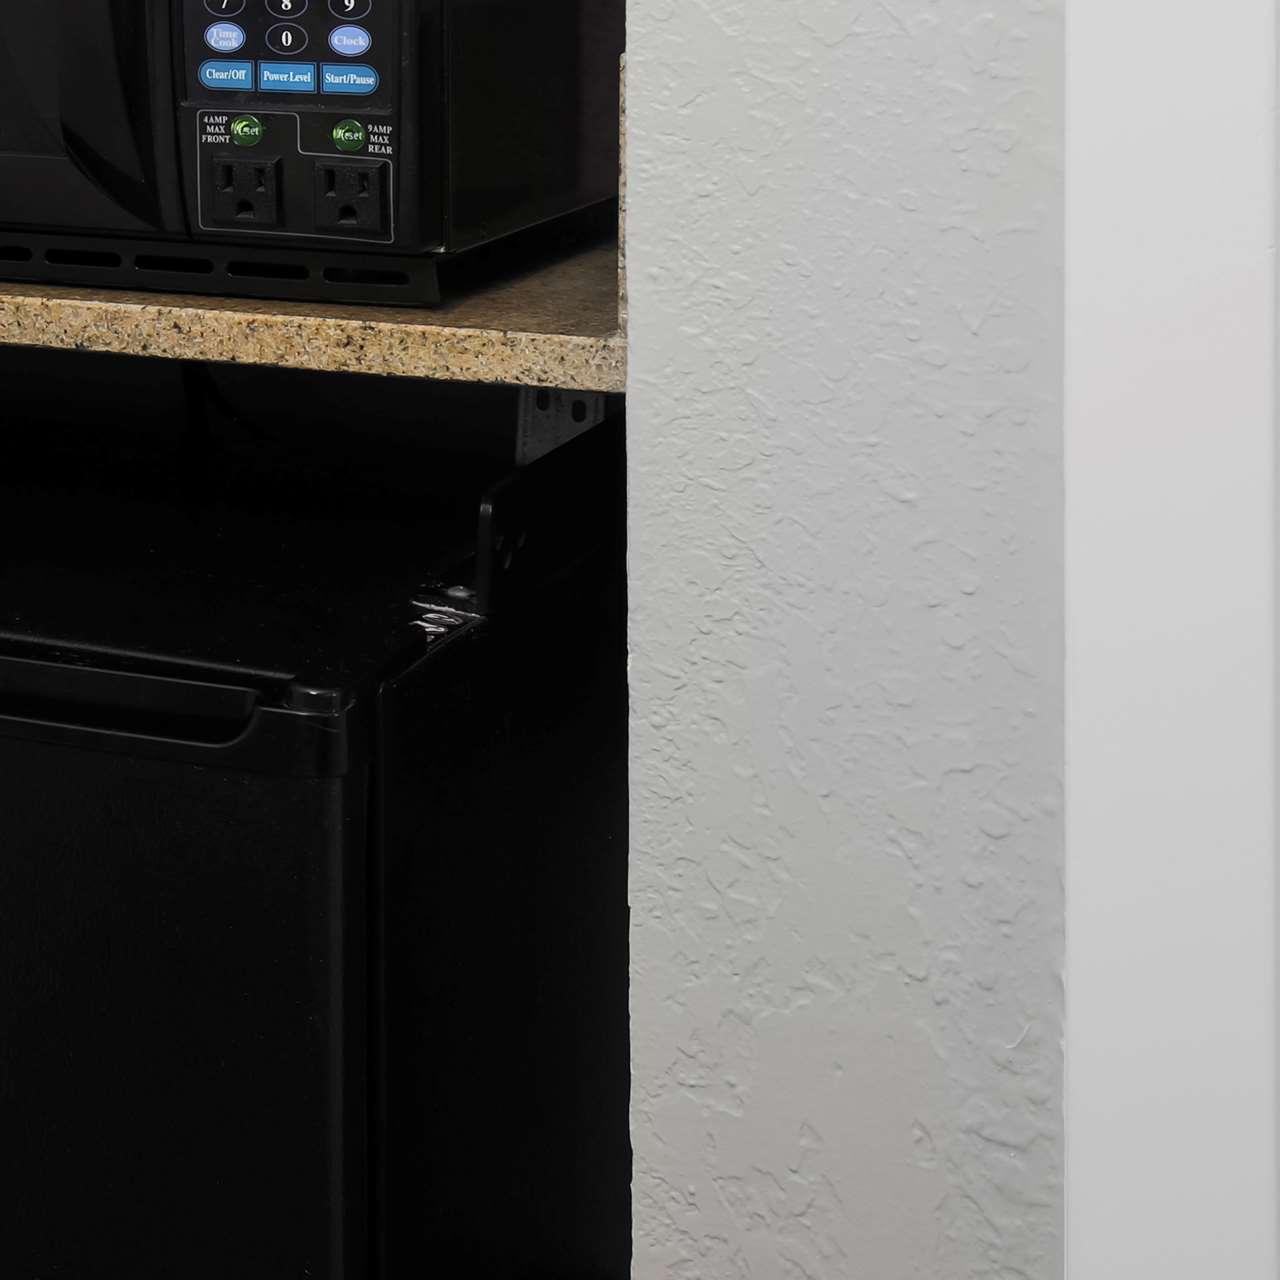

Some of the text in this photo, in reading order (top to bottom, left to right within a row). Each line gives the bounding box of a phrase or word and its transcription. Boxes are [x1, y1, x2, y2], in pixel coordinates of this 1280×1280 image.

[213, 29, 238, 39] Time
[281, 31, 292, 46] 0
[211, 37, 238, 47] Cook
[334, 36, 366, 46] Clock
[206, 69, 246, 80] Clear/Off
[263, 71, 311, 83] Power Level
[325, 73, 375, 85] Start/Pause
[206, 125, 225, 133] MAX
[202, 135, 230, 144] FRONT
[370, 135, 389, 144] MAX
[368, 145, 392, 154] REAR
